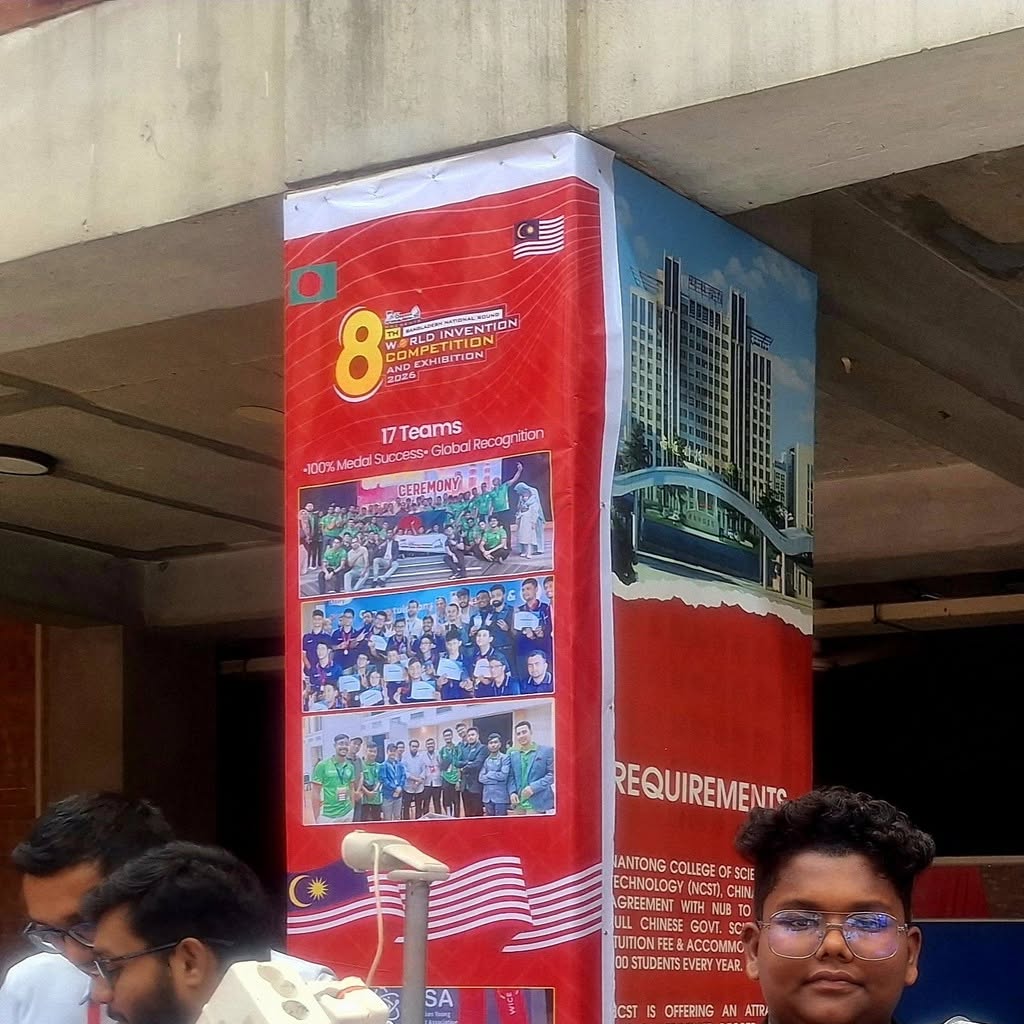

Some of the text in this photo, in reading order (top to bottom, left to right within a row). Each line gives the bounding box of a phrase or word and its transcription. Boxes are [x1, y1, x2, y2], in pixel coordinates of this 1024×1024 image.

[440, 318, 518, 339] INVENTION
[335, 309, 384, 396] 8
[385, 335, 495, 363] COMPETITION
[386, 351, 484, 374] AND EXHIBITION
[386, 372, 417, 384] 2026
[381, 419, 463, 445] 17 Teams
[336, 455, 373, 471] Medal
[430, 440, 471, 456] Global
[473, 428, 544, 450] Recognition
[398, 476, 461, 497] CEREMONY
[669, 860, 716, 877] COLLEGE
[718, 865, 732, 879] OF
[734, 866, 755, 881] SCIE
[613, 875, 684, 895] ECHNOLOGY
[687, 880, 723, 899] (NCST),
[681, 900, 705, 914] WITH
[712, 902, 732, 915] NUB
[738, 904, 751, 917] TO
[614, 915, 633, 930] ULL
[640, 917, 684, 932] CHINESE
[690, 921, 722, 934] GOVT.
[657, 938, 674, 951] FEE
[676, 938, 684, 951] &
[686, 940, 745, 954] ACCOMMO
[631, 957, 682, 970] STUDENTS
[683, 958, 713, 972] EVERY
[715, 958, 744, 972] YEAR.
[647, 1005, 656, 1018] IS
[664, 1004, 715, 1018] OFFERING
[721, 1004, 738, 1017] AN
